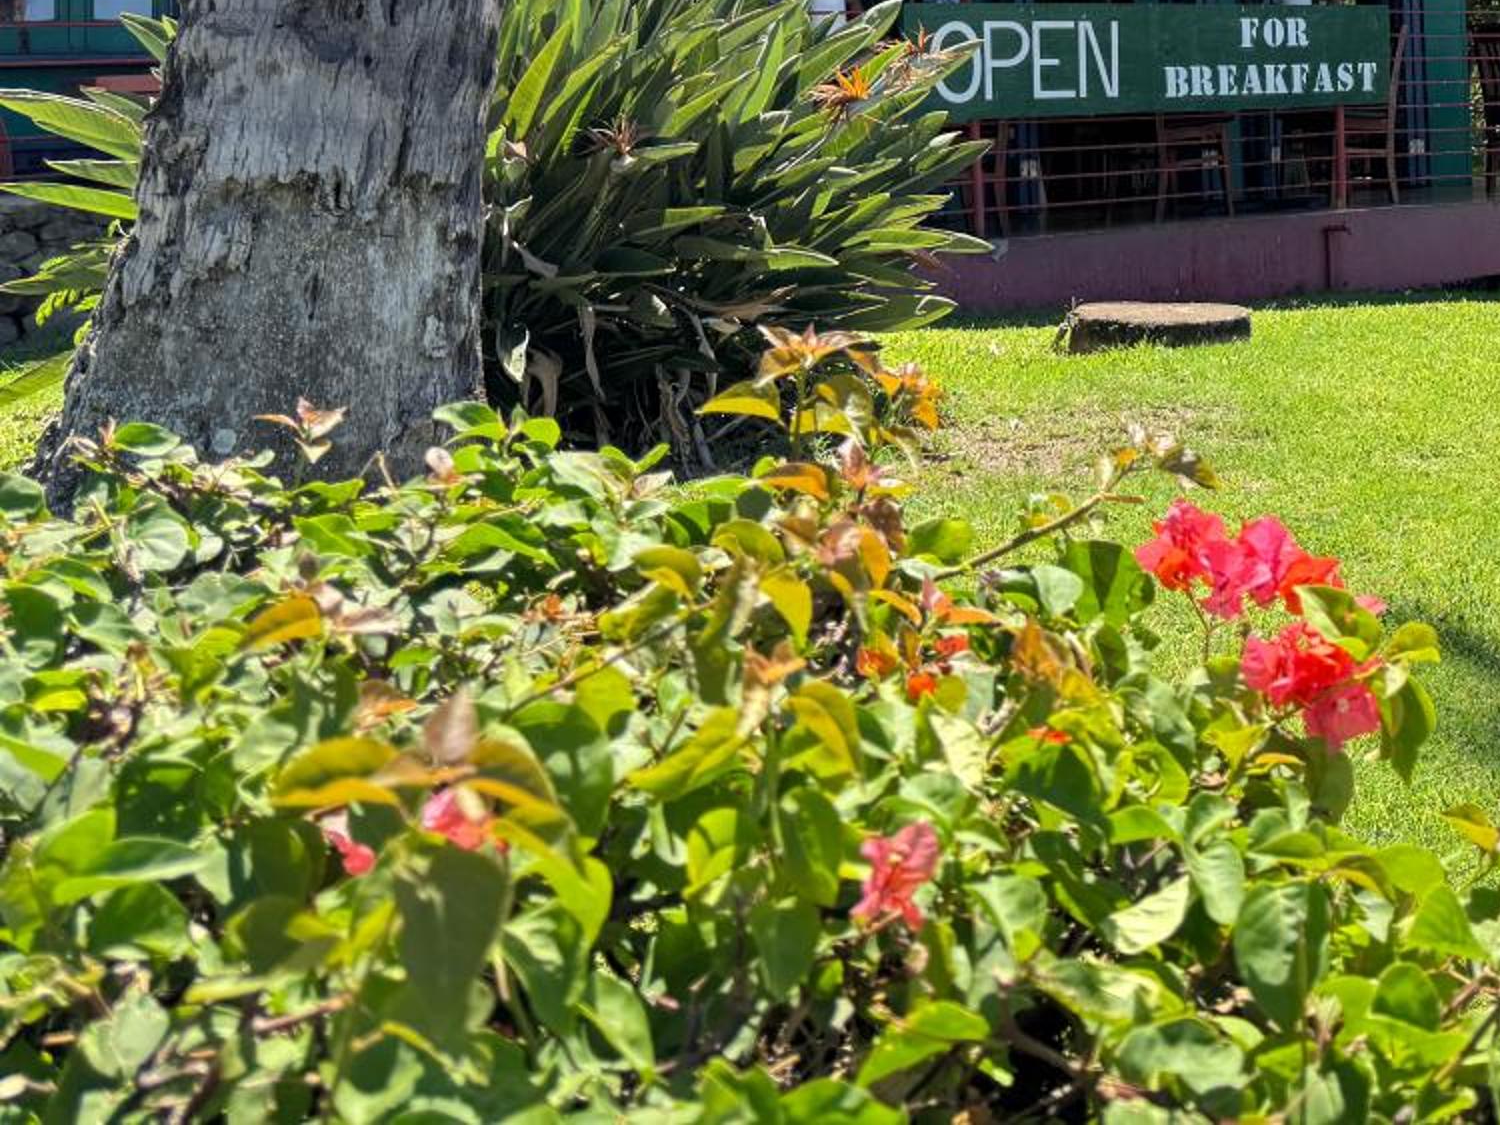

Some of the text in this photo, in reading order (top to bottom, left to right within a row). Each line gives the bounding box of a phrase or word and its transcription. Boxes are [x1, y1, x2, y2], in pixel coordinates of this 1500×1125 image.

[1240, 17, 1310, 48] FOR
[929, 20, 1119, 103] OPEN
[1165, 61, 1377, 98] BREAKFAST
